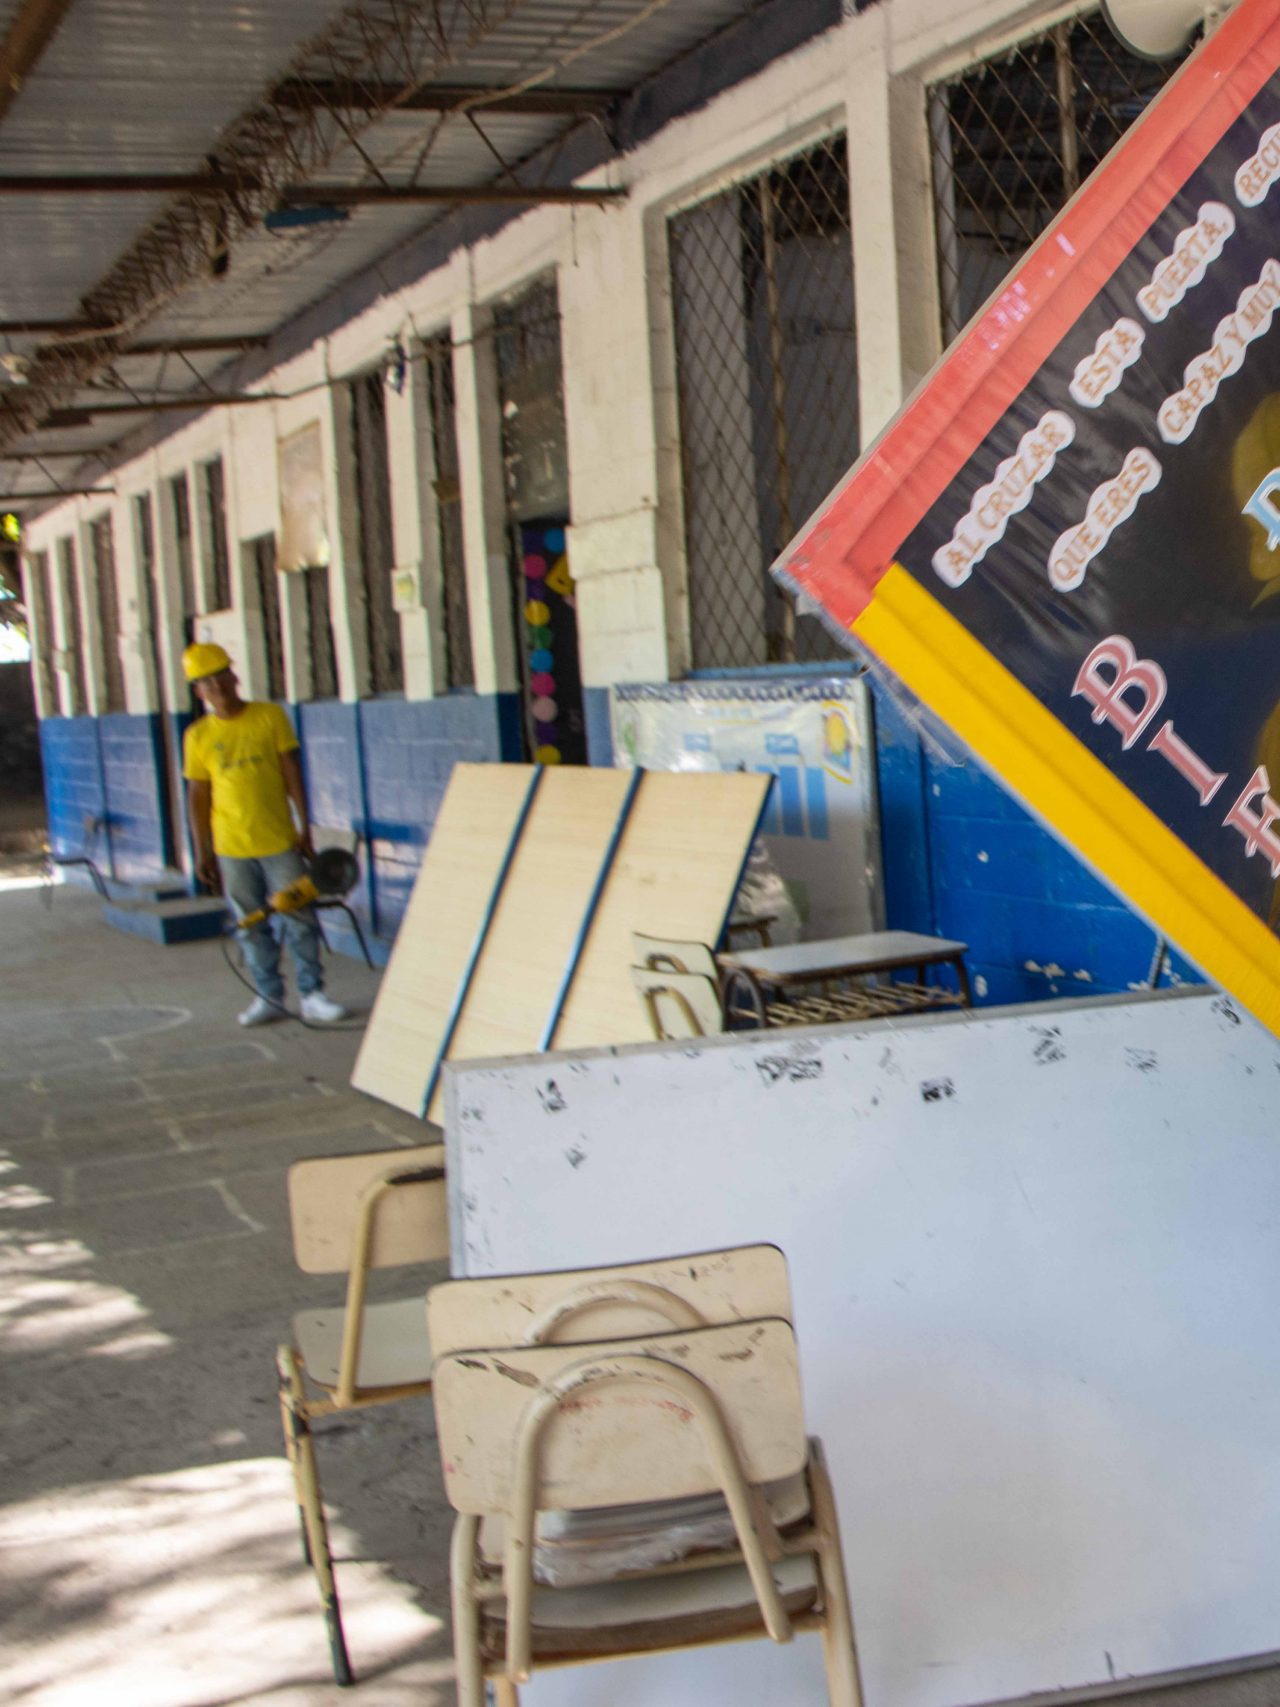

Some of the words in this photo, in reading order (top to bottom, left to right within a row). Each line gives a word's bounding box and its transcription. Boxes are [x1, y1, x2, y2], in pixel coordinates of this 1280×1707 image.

[945, 533, 985, 578] AL
[976, 422, 1068, 531] CRUZAR
[1076, 327, 1138, 400] ESTA
[1054, 523, 1101, 582] QUE
[1092, 455, 1151, 529] ERES
[1162, 342, 1234, 434] CAPAZ
[1223, 316, 1247, 350] Y
